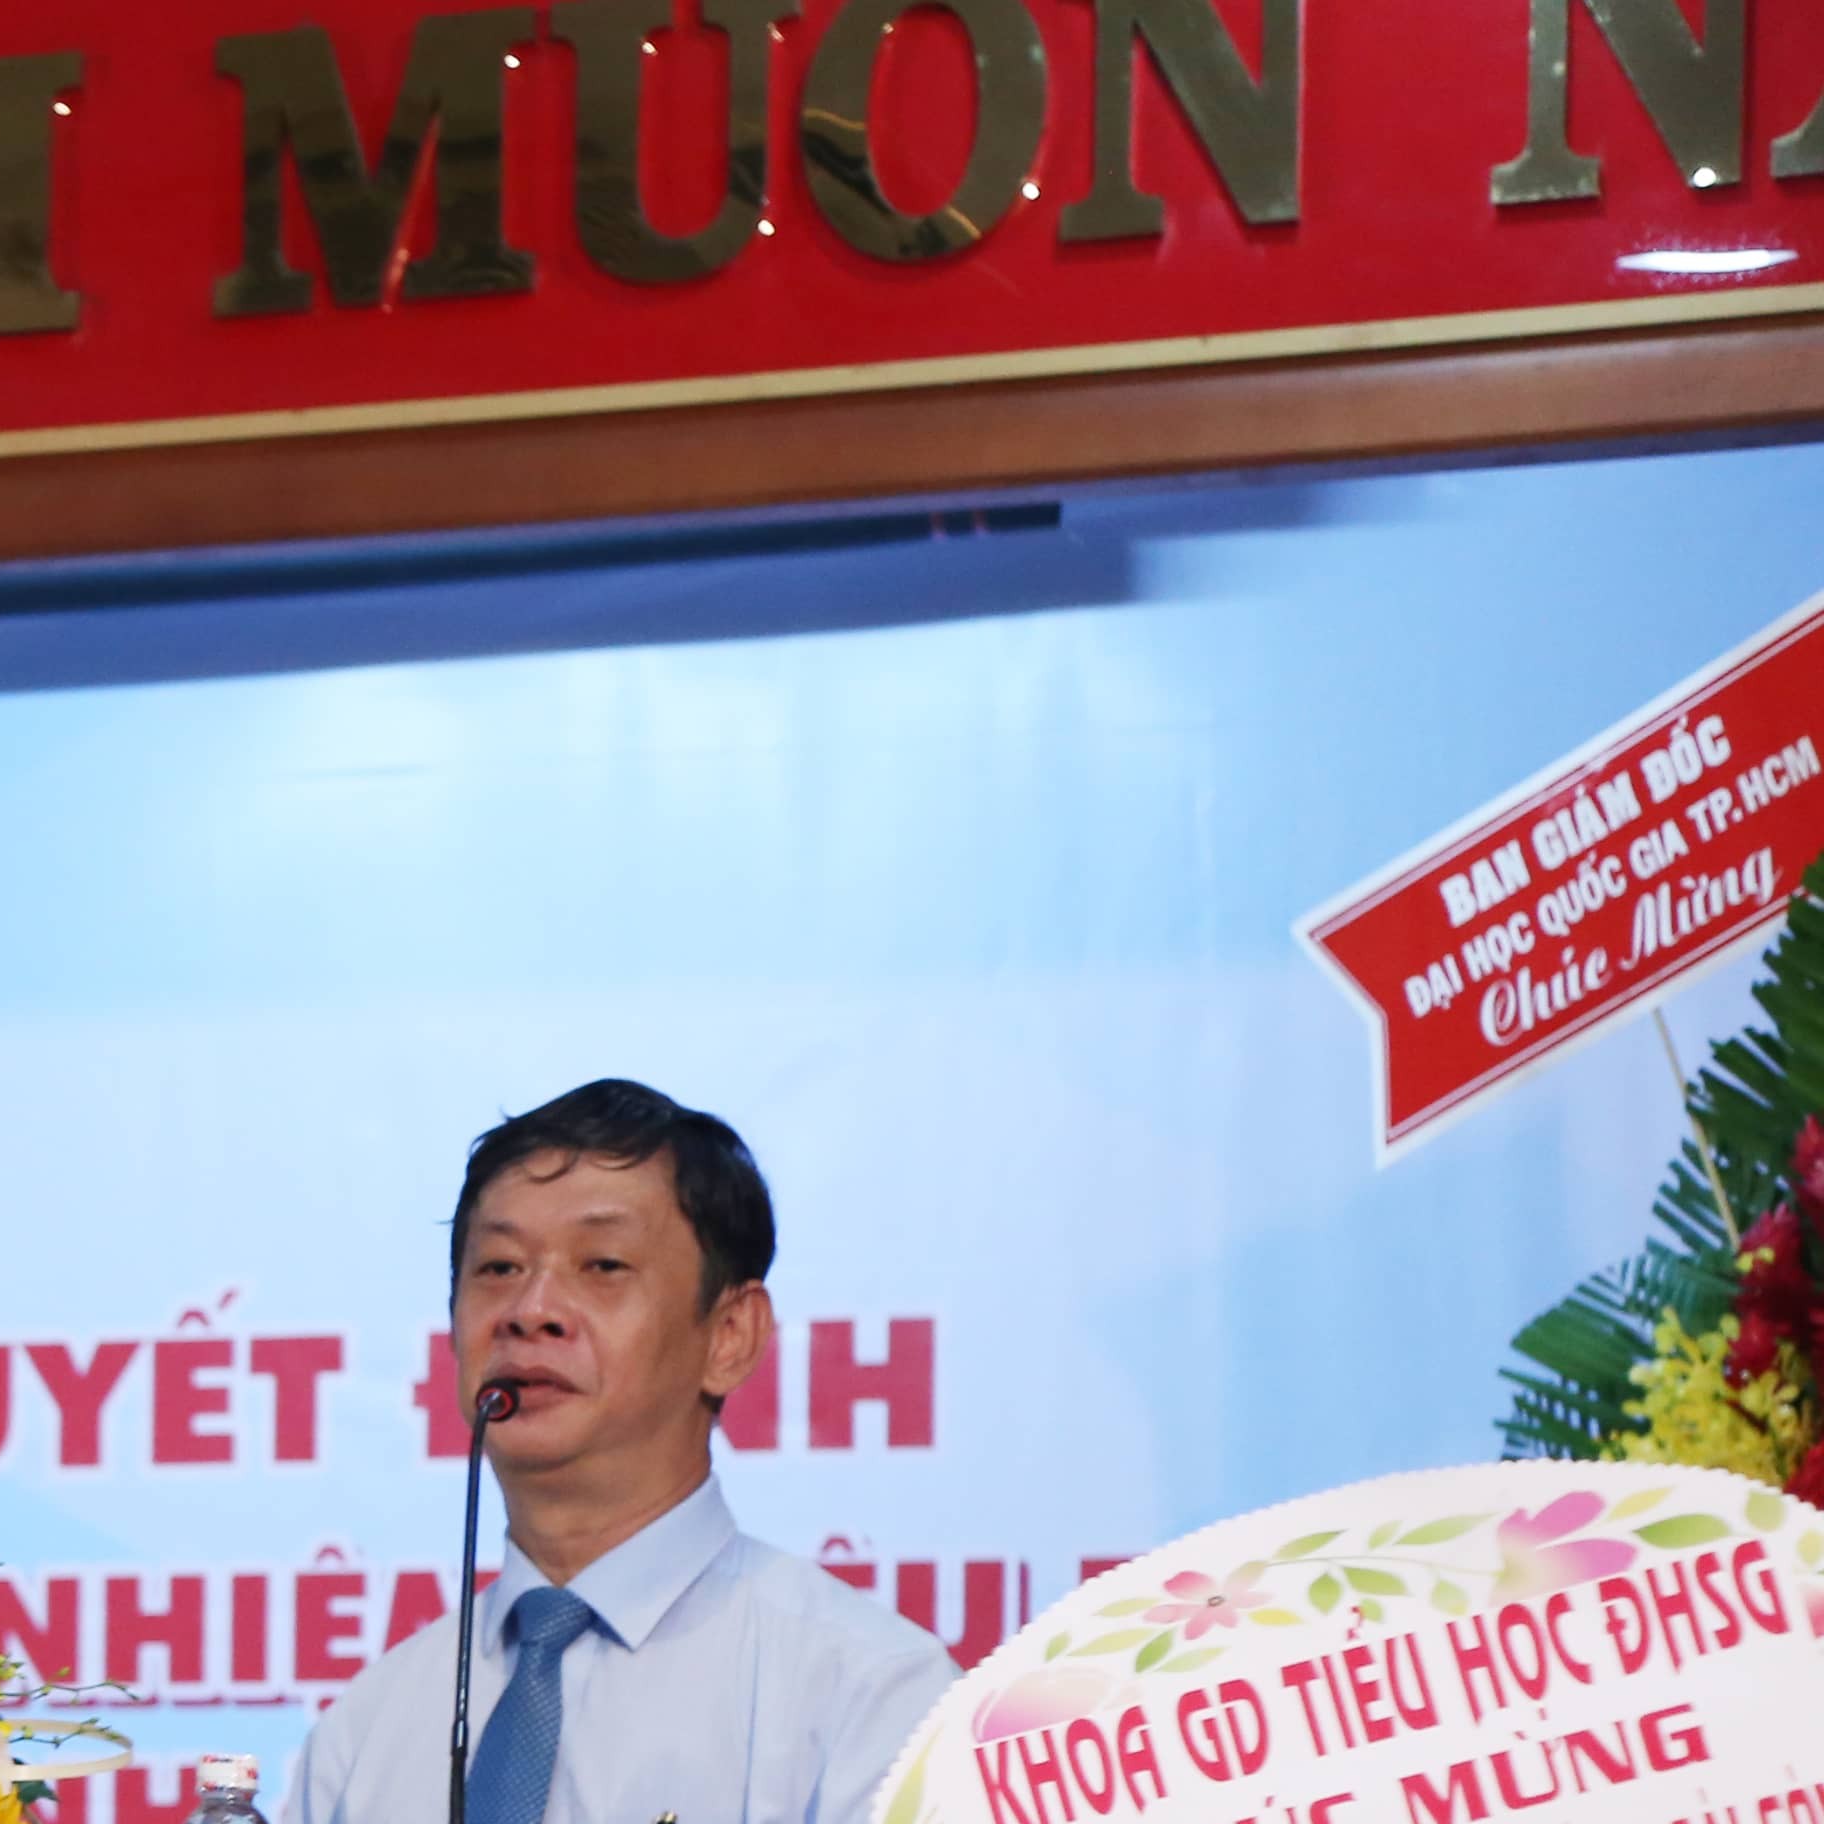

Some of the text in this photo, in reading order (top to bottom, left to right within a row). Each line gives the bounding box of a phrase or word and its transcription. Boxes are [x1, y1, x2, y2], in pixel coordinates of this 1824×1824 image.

[1403, 736, 1822, 1019] ĐẠI HỌC QUỐC GIA TP.HCM
[1439, 715, 1732, 927] BAN GIÁM ĐỐC
[1480, 847, 1784, 1047] Chúc Mừng
[1176, 1678, 1271, 1782] GD
[1280, 1605, 1441, 1757] TIỂU
[1446, 1601, 1594, 1726] HỌC
[1598, 1539, 1792, 1674] ĐHSG
